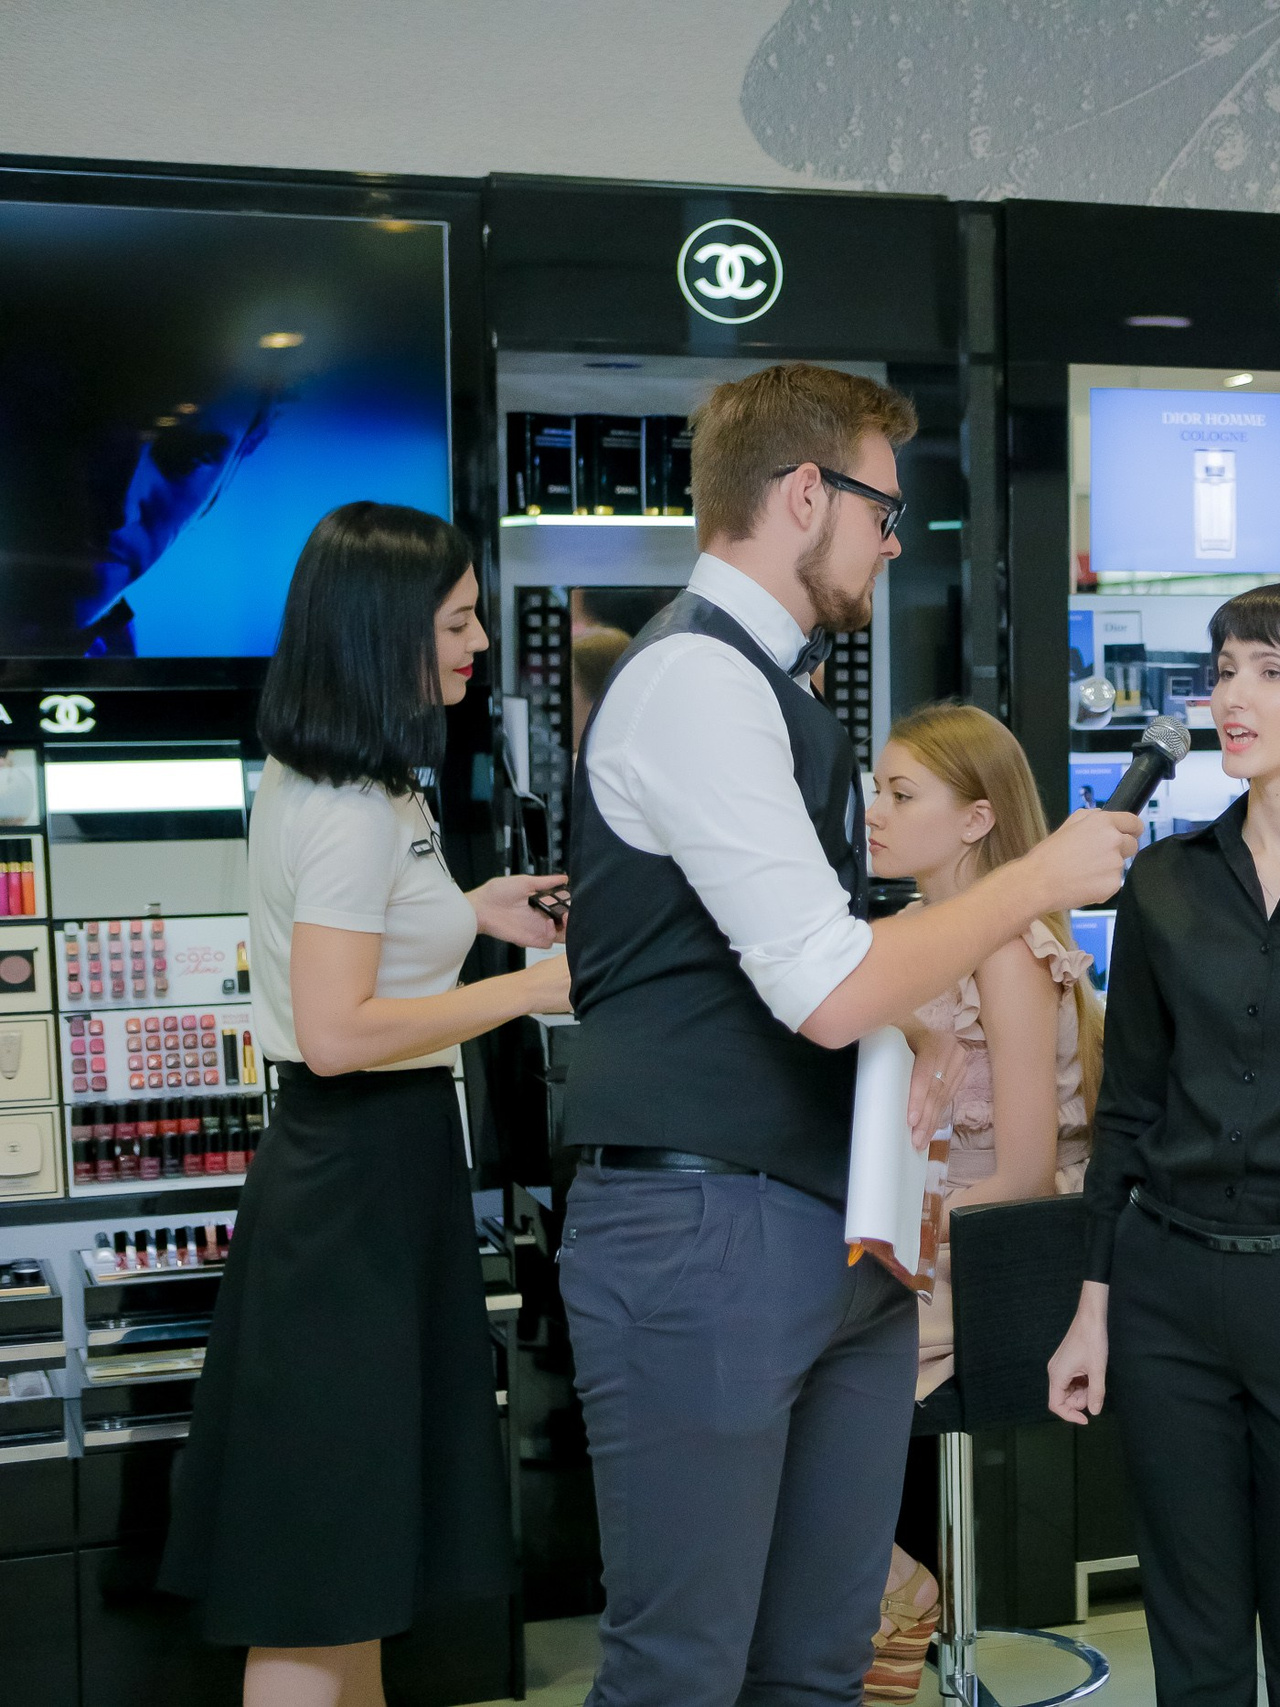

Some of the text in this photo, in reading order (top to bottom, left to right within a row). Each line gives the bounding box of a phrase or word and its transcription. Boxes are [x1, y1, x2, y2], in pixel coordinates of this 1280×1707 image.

[1161, 411, 1267, 427] DIOR HOMME
[1180, 430, 1248, 443] COLOGNE
[175, 951, 226, 963] COCO
